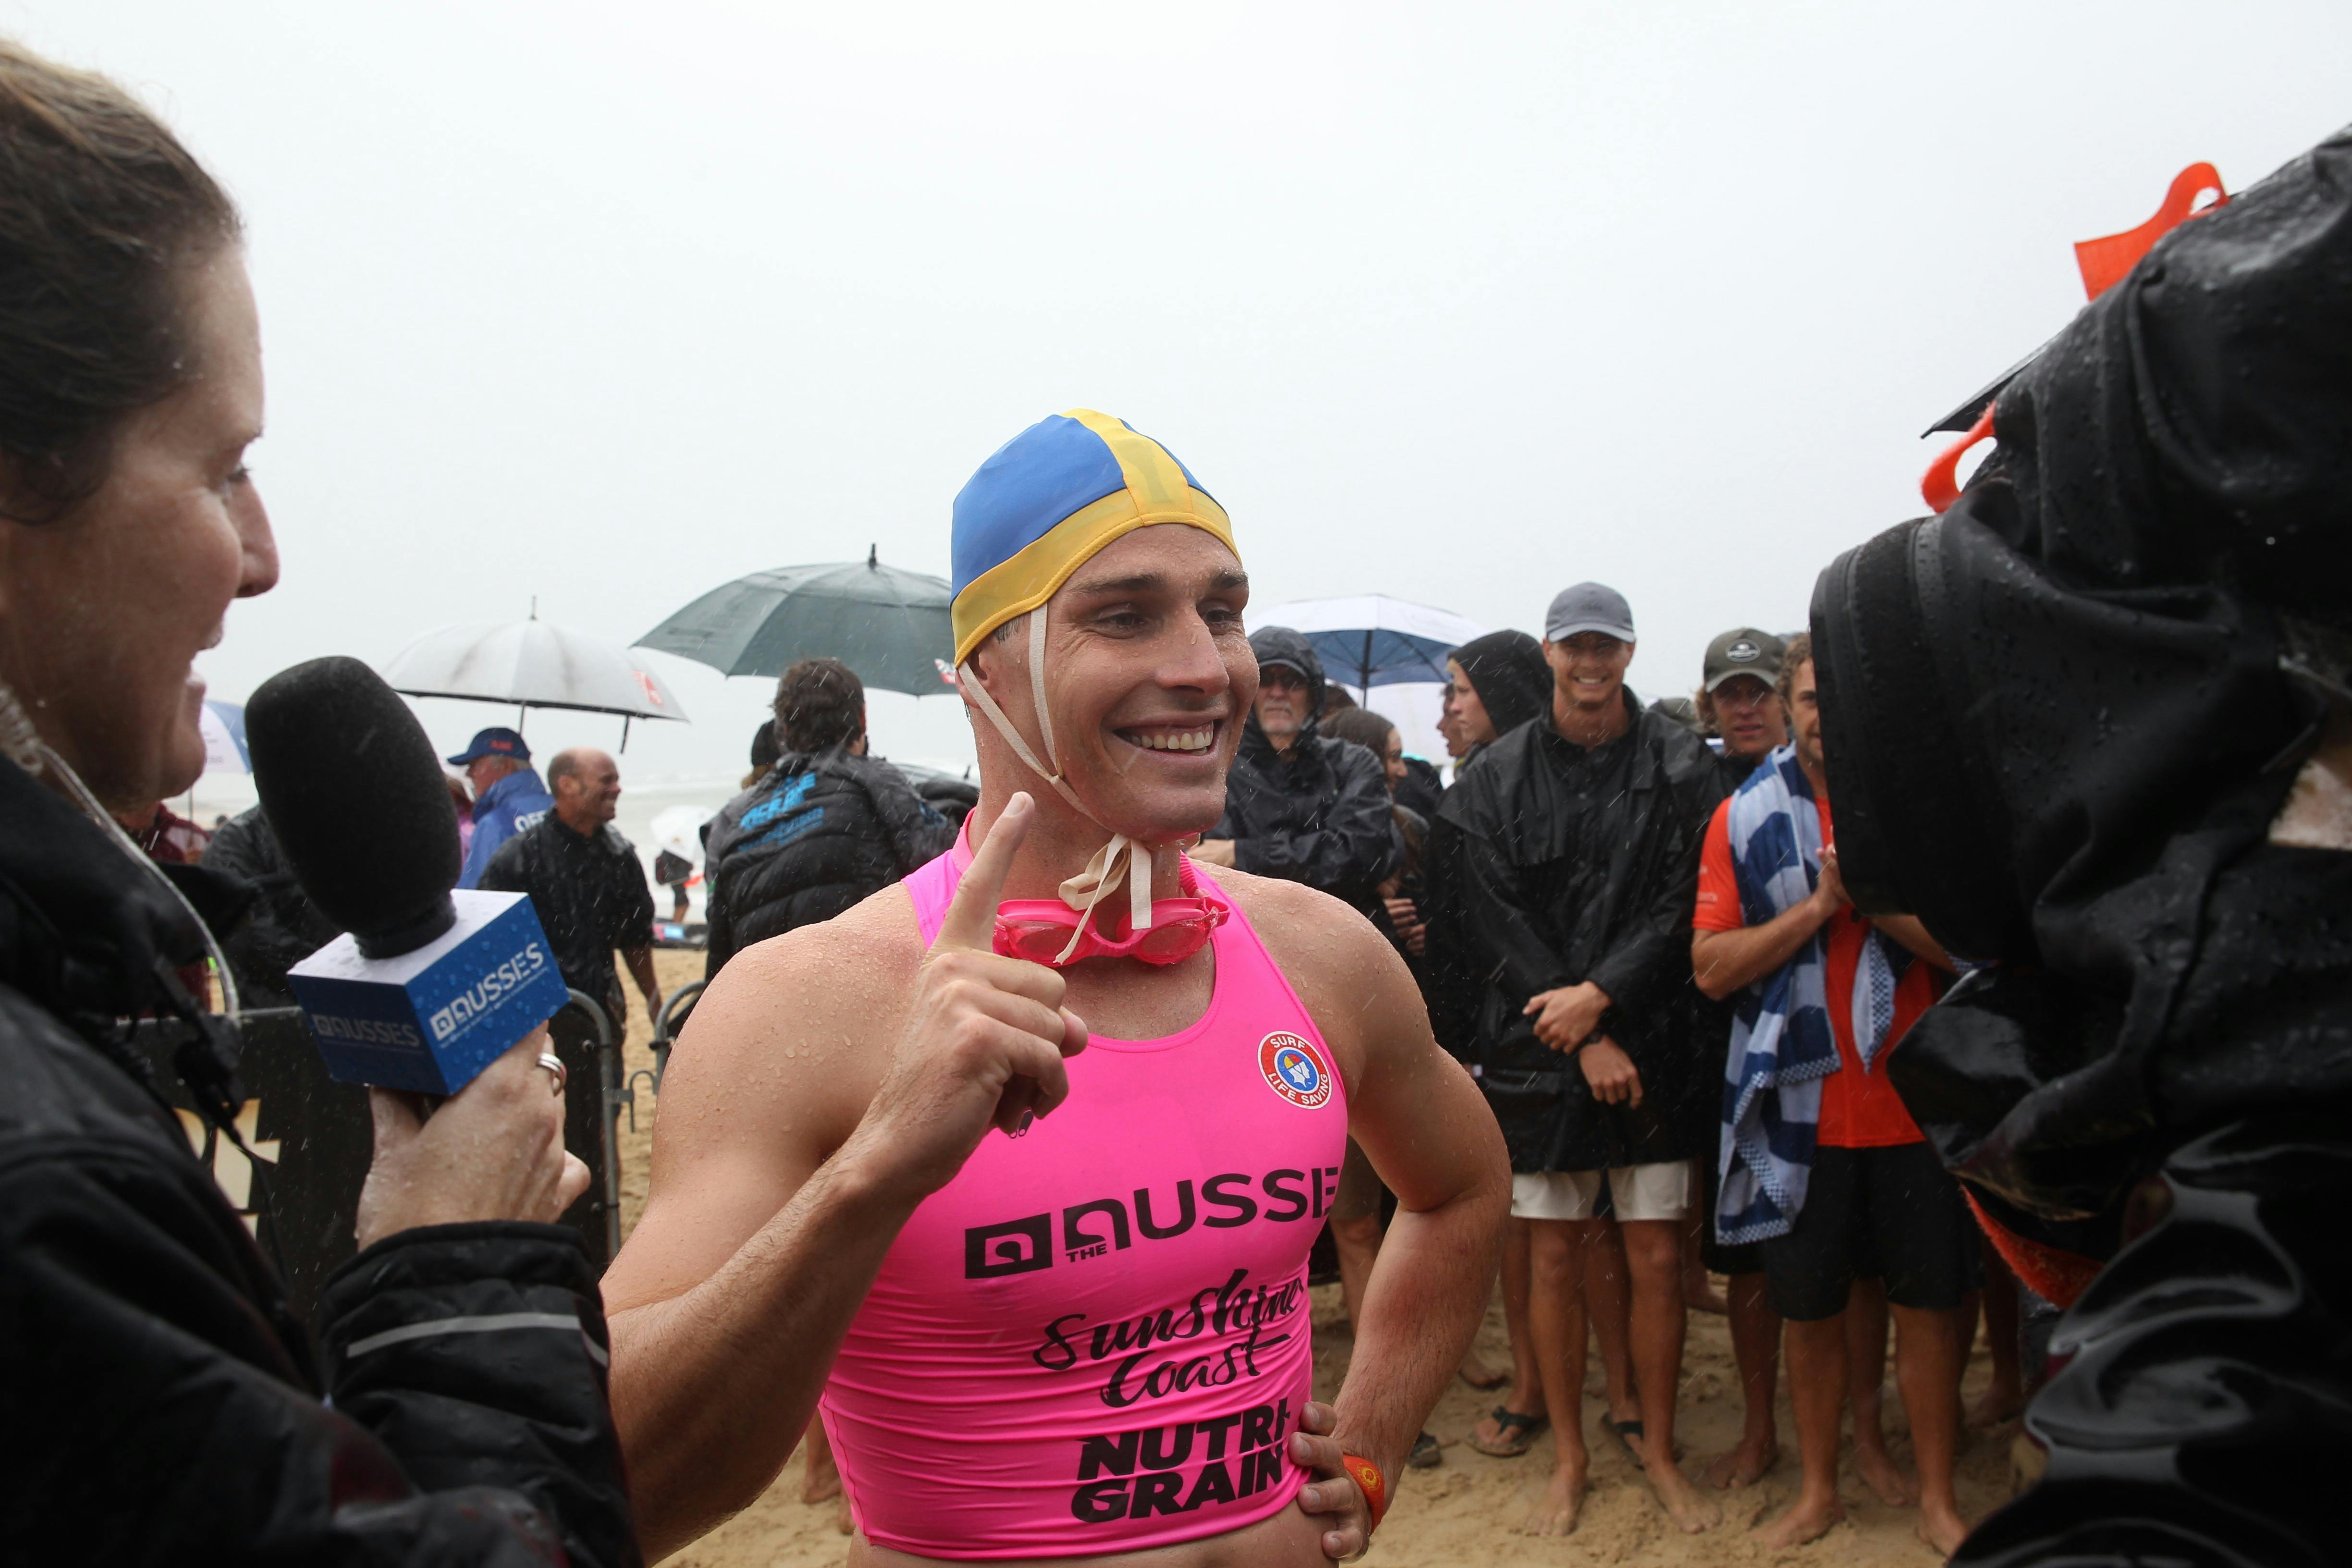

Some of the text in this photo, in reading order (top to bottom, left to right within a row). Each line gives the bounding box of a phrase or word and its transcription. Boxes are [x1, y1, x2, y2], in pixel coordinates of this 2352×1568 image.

[1270, 1035, 1306, 1049] SURF
[1268, 1072, 1329, 1105] LIFE SAVING
[1066, 1243, 1107, 1262] THE
[1032, 1268, 1304, 1371] Sunshine
[1100, 1325, 1292, 1408] Coast
[1071, 1441, 1284, 1524] GRAIN
